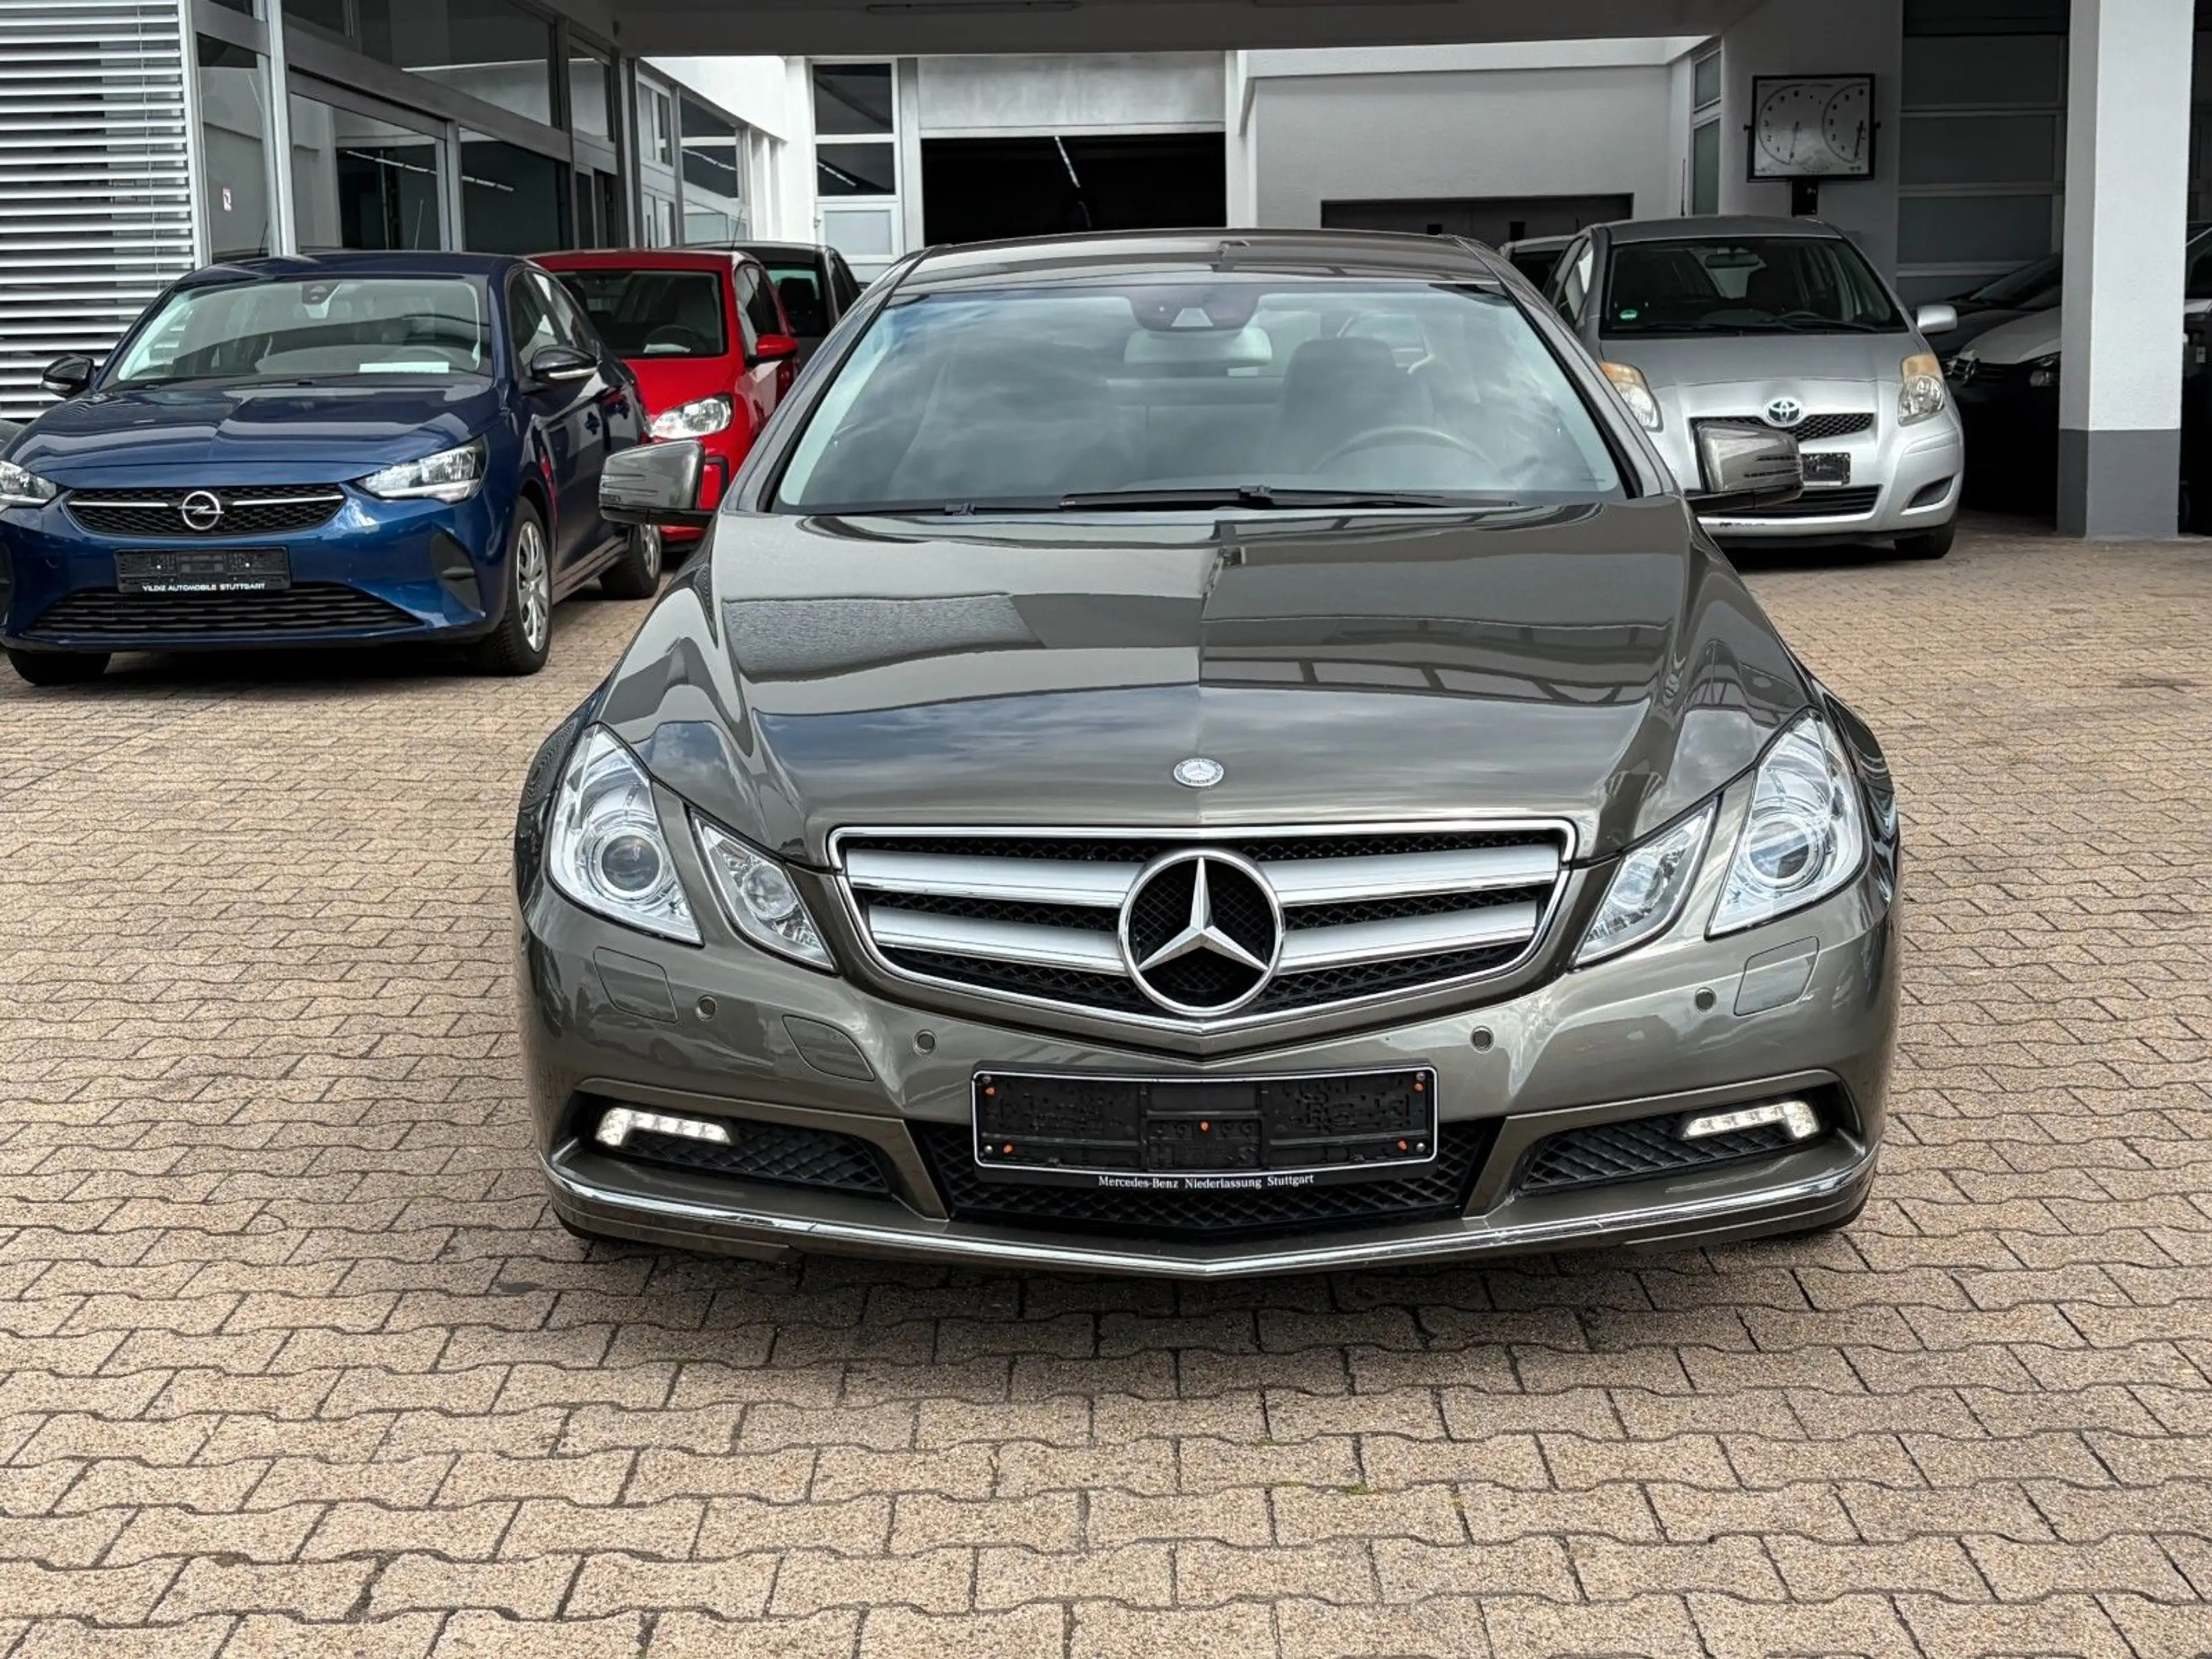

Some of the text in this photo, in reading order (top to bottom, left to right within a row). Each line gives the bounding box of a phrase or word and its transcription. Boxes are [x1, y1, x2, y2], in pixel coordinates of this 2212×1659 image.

[168, 584, 217, 592] AUTOMOBILE
[219, 582, 265, 591] STUTTGART
[1099, 1174, 1315, 1190] Mercedes-Benz Niederlassung Stuttgart
